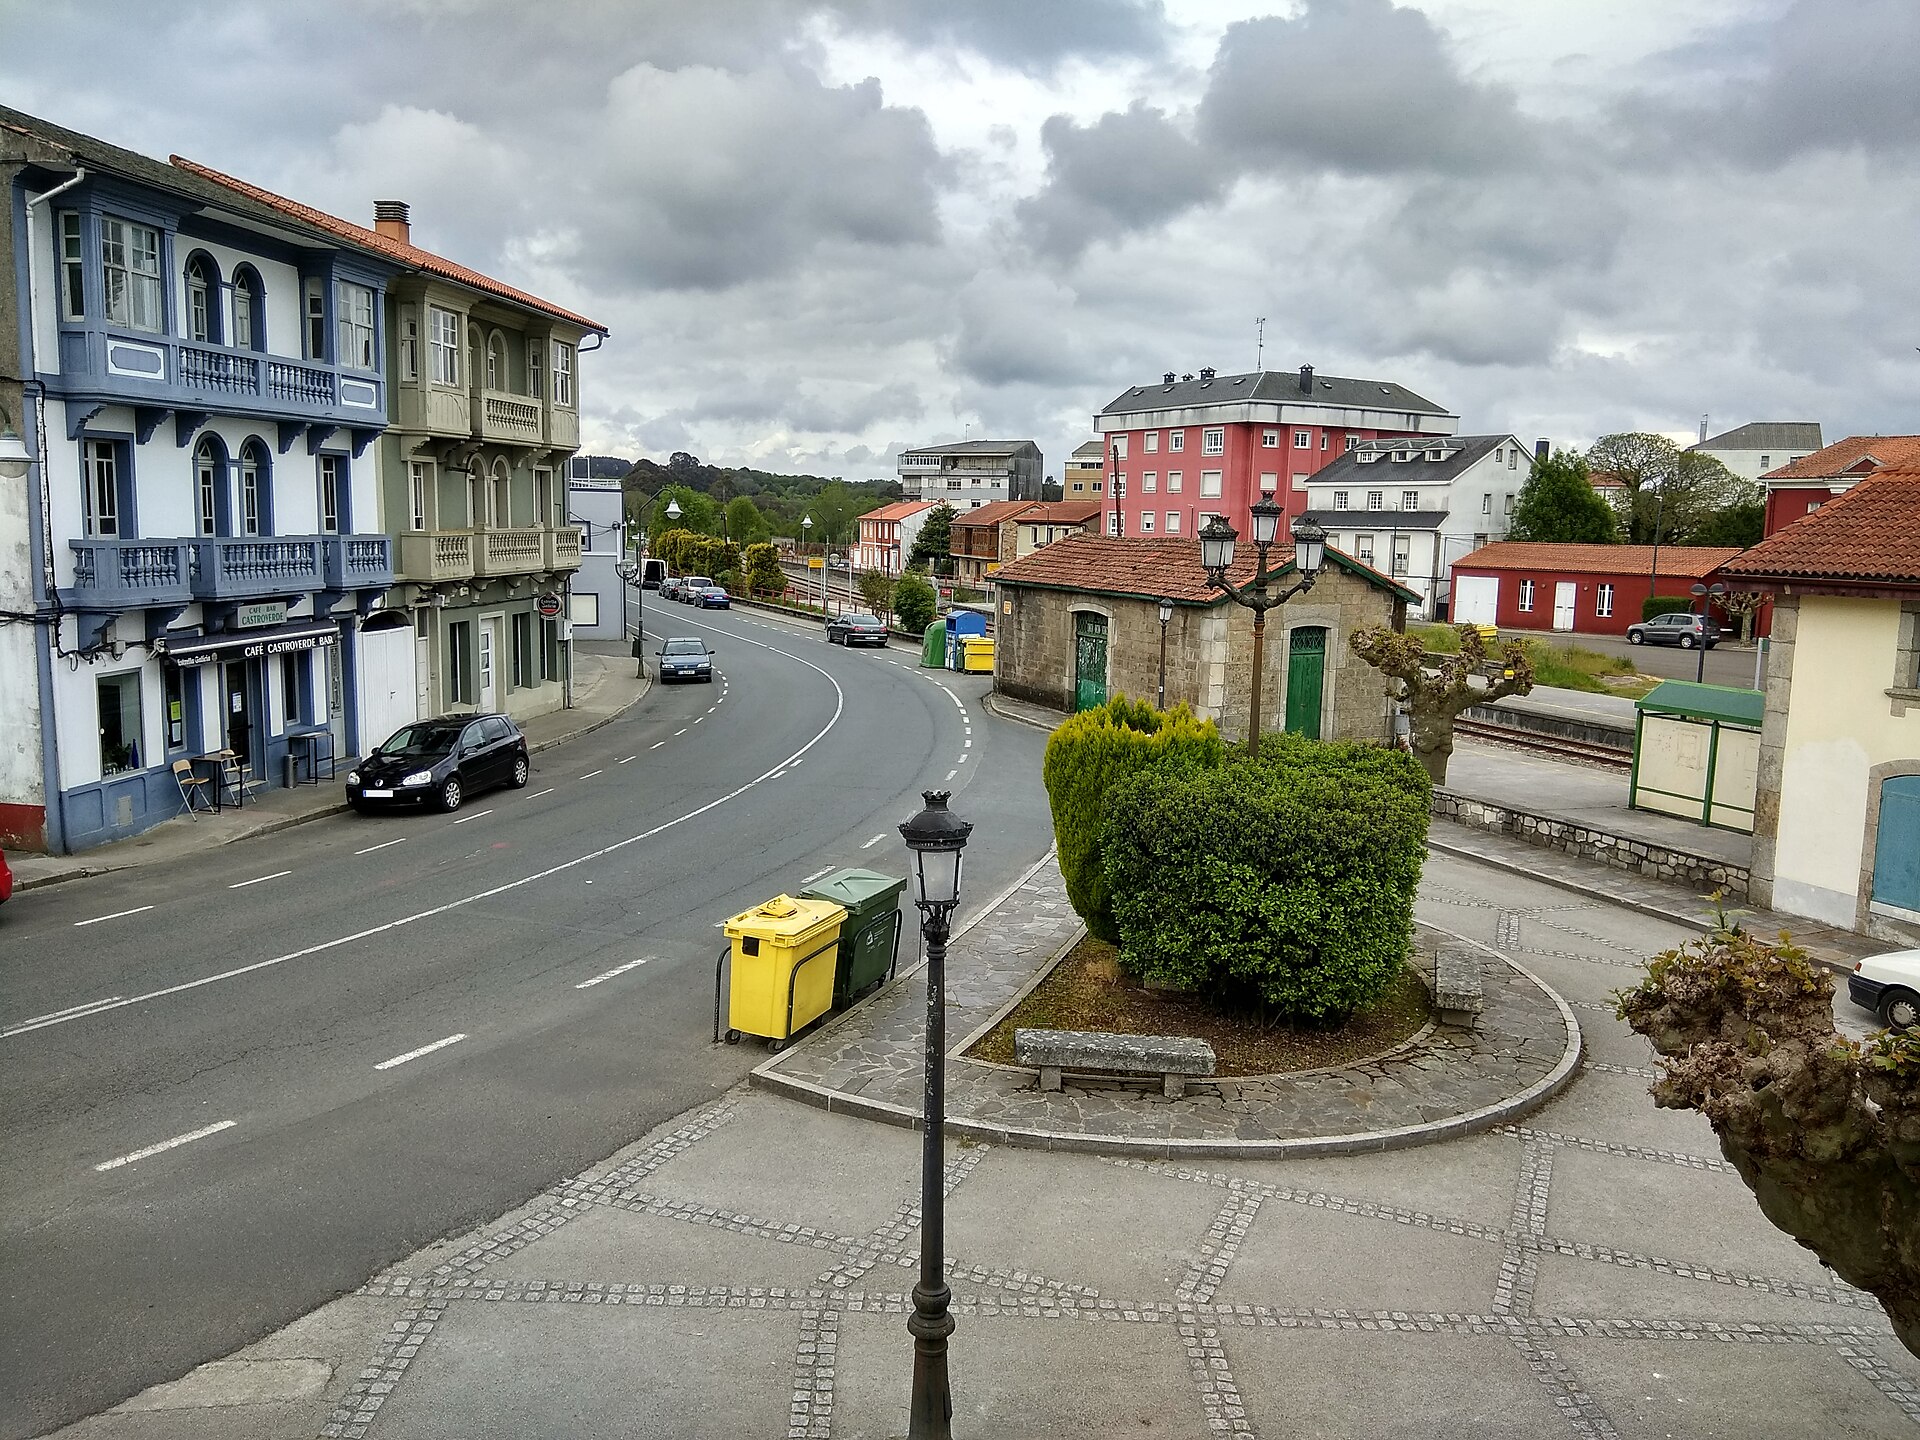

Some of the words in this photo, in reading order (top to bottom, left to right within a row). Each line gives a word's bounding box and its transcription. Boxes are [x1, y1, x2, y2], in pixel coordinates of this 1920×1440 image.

[242, 612, 284, 625] CASTROVERDE
[245, 642, 264, 657] CAFÉ
[267, 637, 316, 654] CASTROVERDE
[319, 635, 334, 646] BAR
